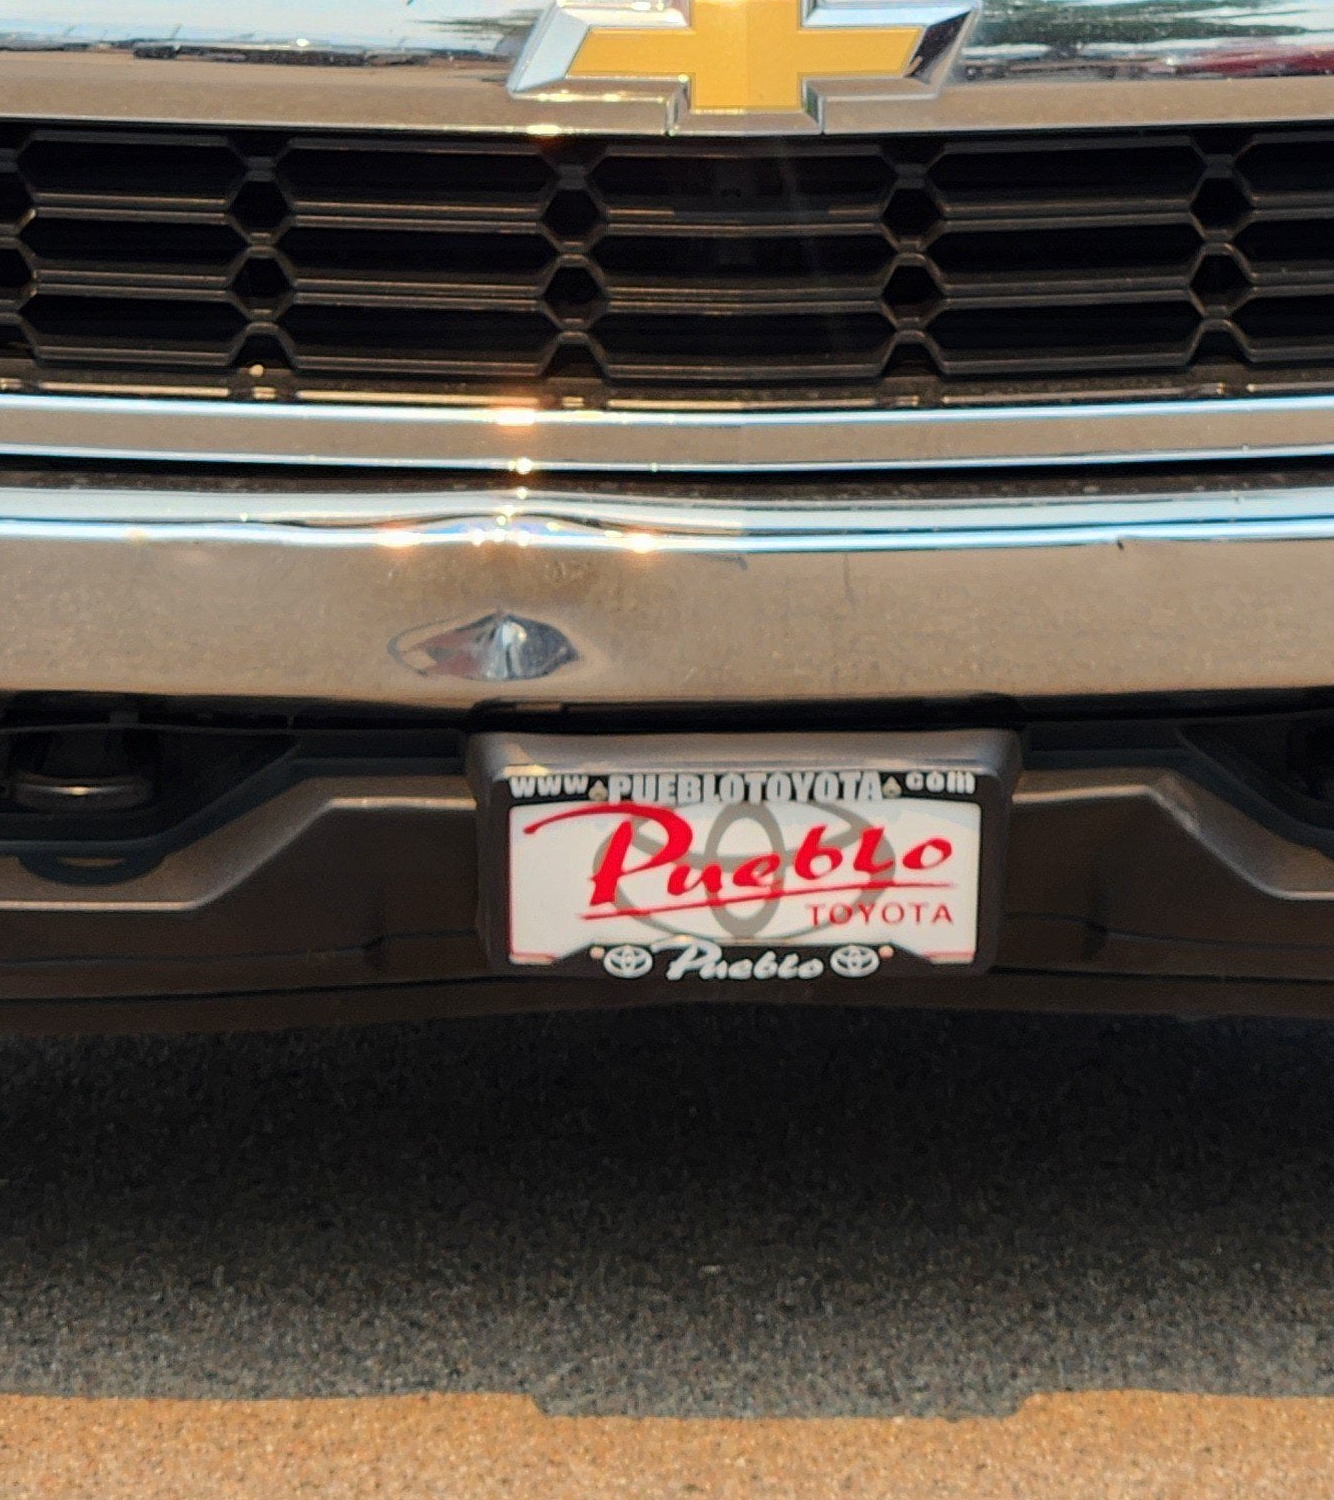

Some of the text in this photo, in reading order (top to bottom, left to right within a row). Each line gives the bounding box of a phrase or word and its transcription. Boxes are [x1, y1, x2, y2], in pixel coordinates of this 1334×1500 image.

[524, 803, 952, 906] Pueblo
[807, 902, 954, 926] TOYOTA
[651, 936, 824, 980] Pueblo
